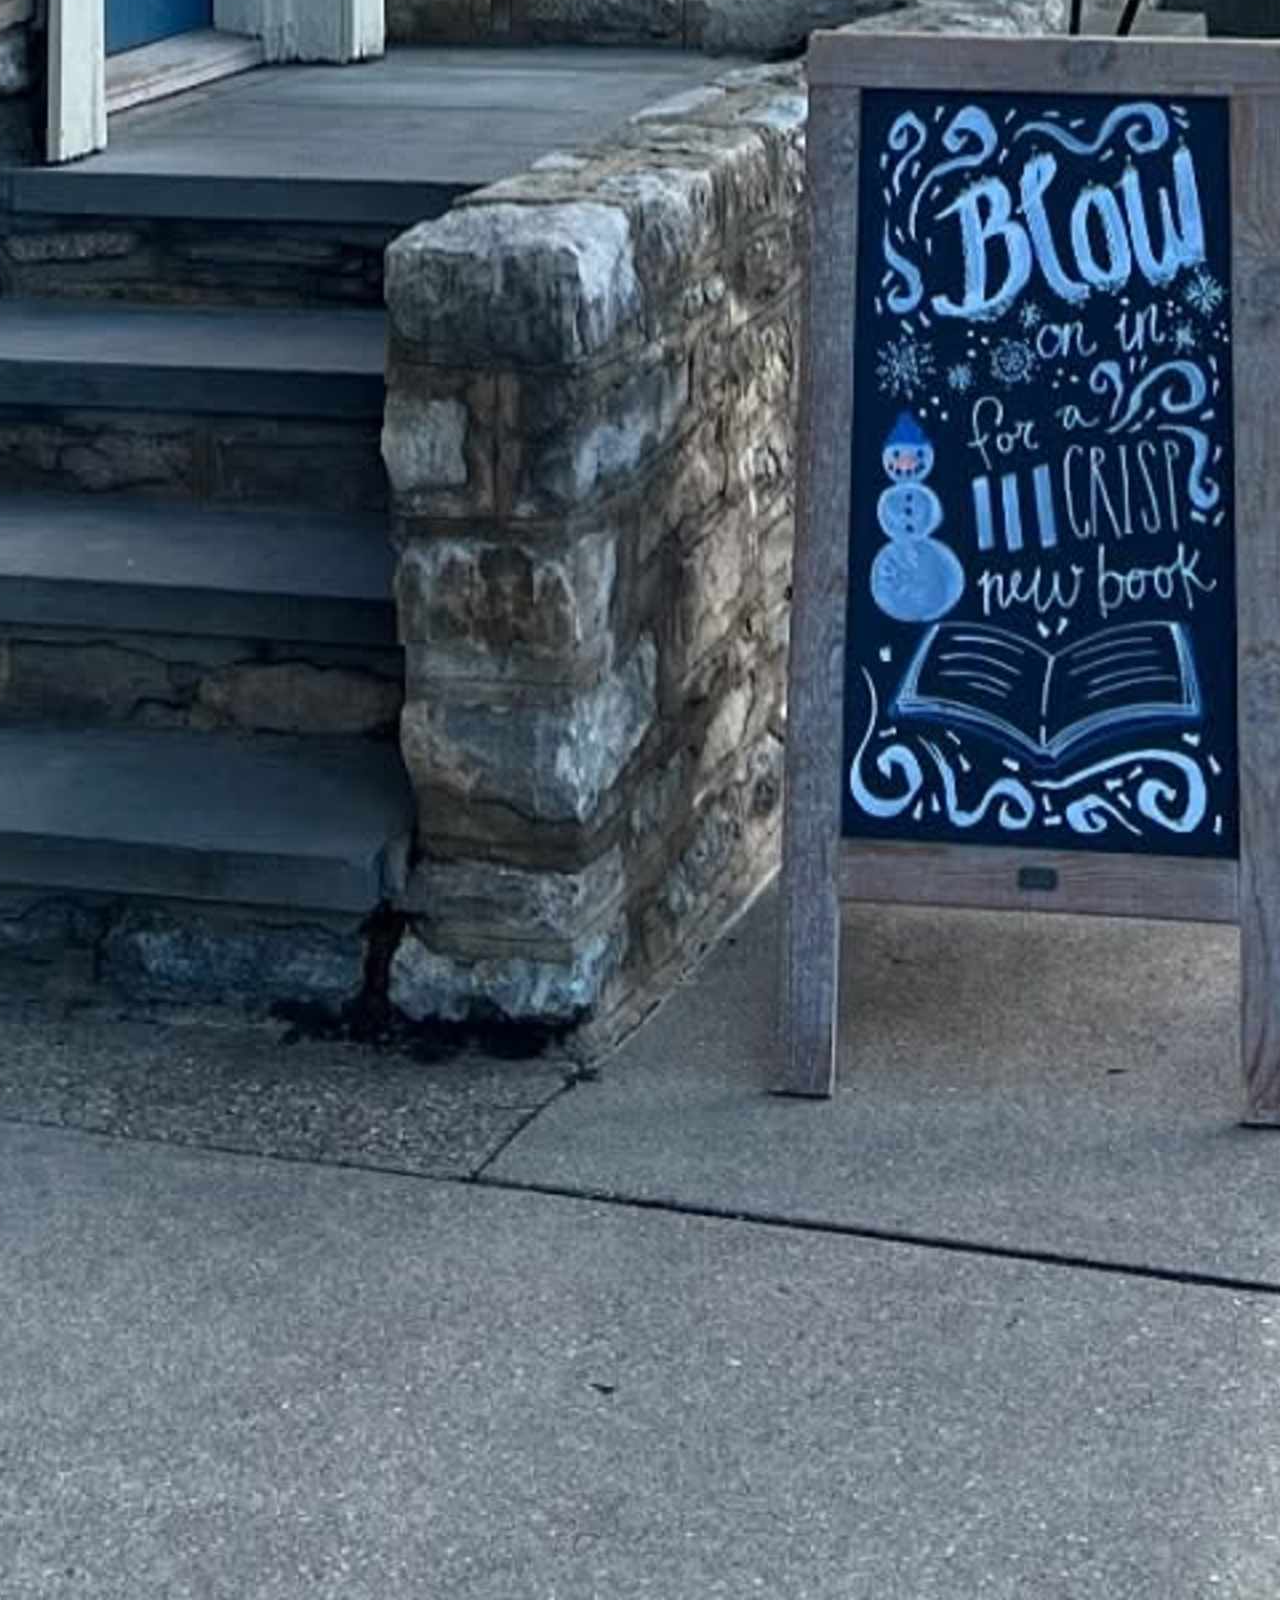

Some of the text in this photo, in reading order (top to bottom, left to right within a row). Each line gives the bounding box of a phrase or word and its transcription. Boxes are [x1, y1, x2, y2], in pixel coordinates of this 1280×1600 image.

[1036, 297, 1166, 358] on in
[966, 395, 1101, 471] for a
[1062, 439, 1181, 540] CRISP
[977, 540, 1218, 620] new book
